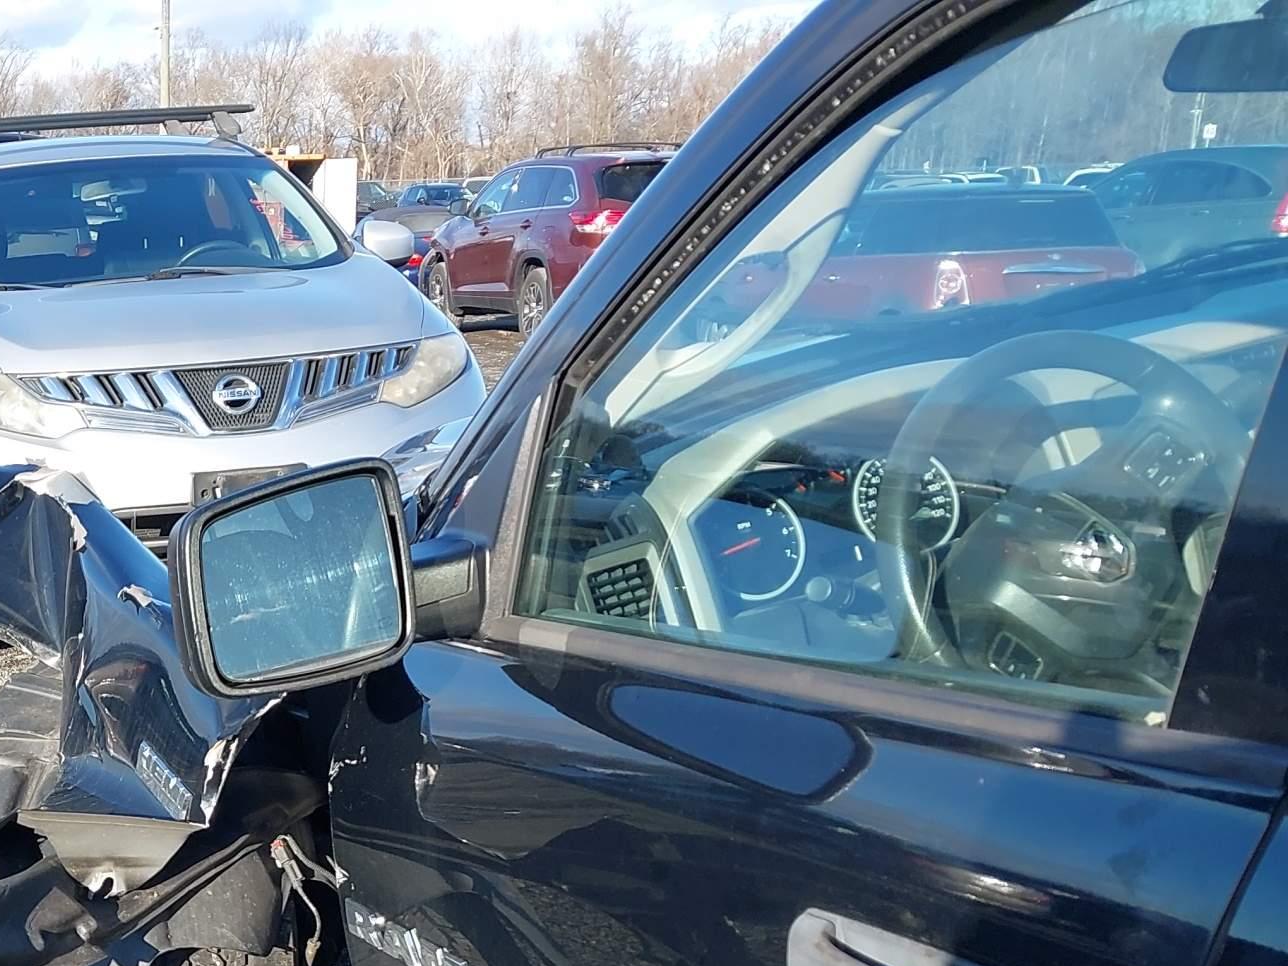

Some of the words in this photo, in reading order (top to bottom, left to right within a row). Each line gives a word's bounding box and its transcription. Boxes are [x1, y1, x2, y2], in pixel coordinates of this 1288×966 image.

[218, 389, 257, 399] NISSAN
[765, 507, 773, 516] 5
[781, 526, 789, 535] 6
[784, 548, 792, 558] 7
